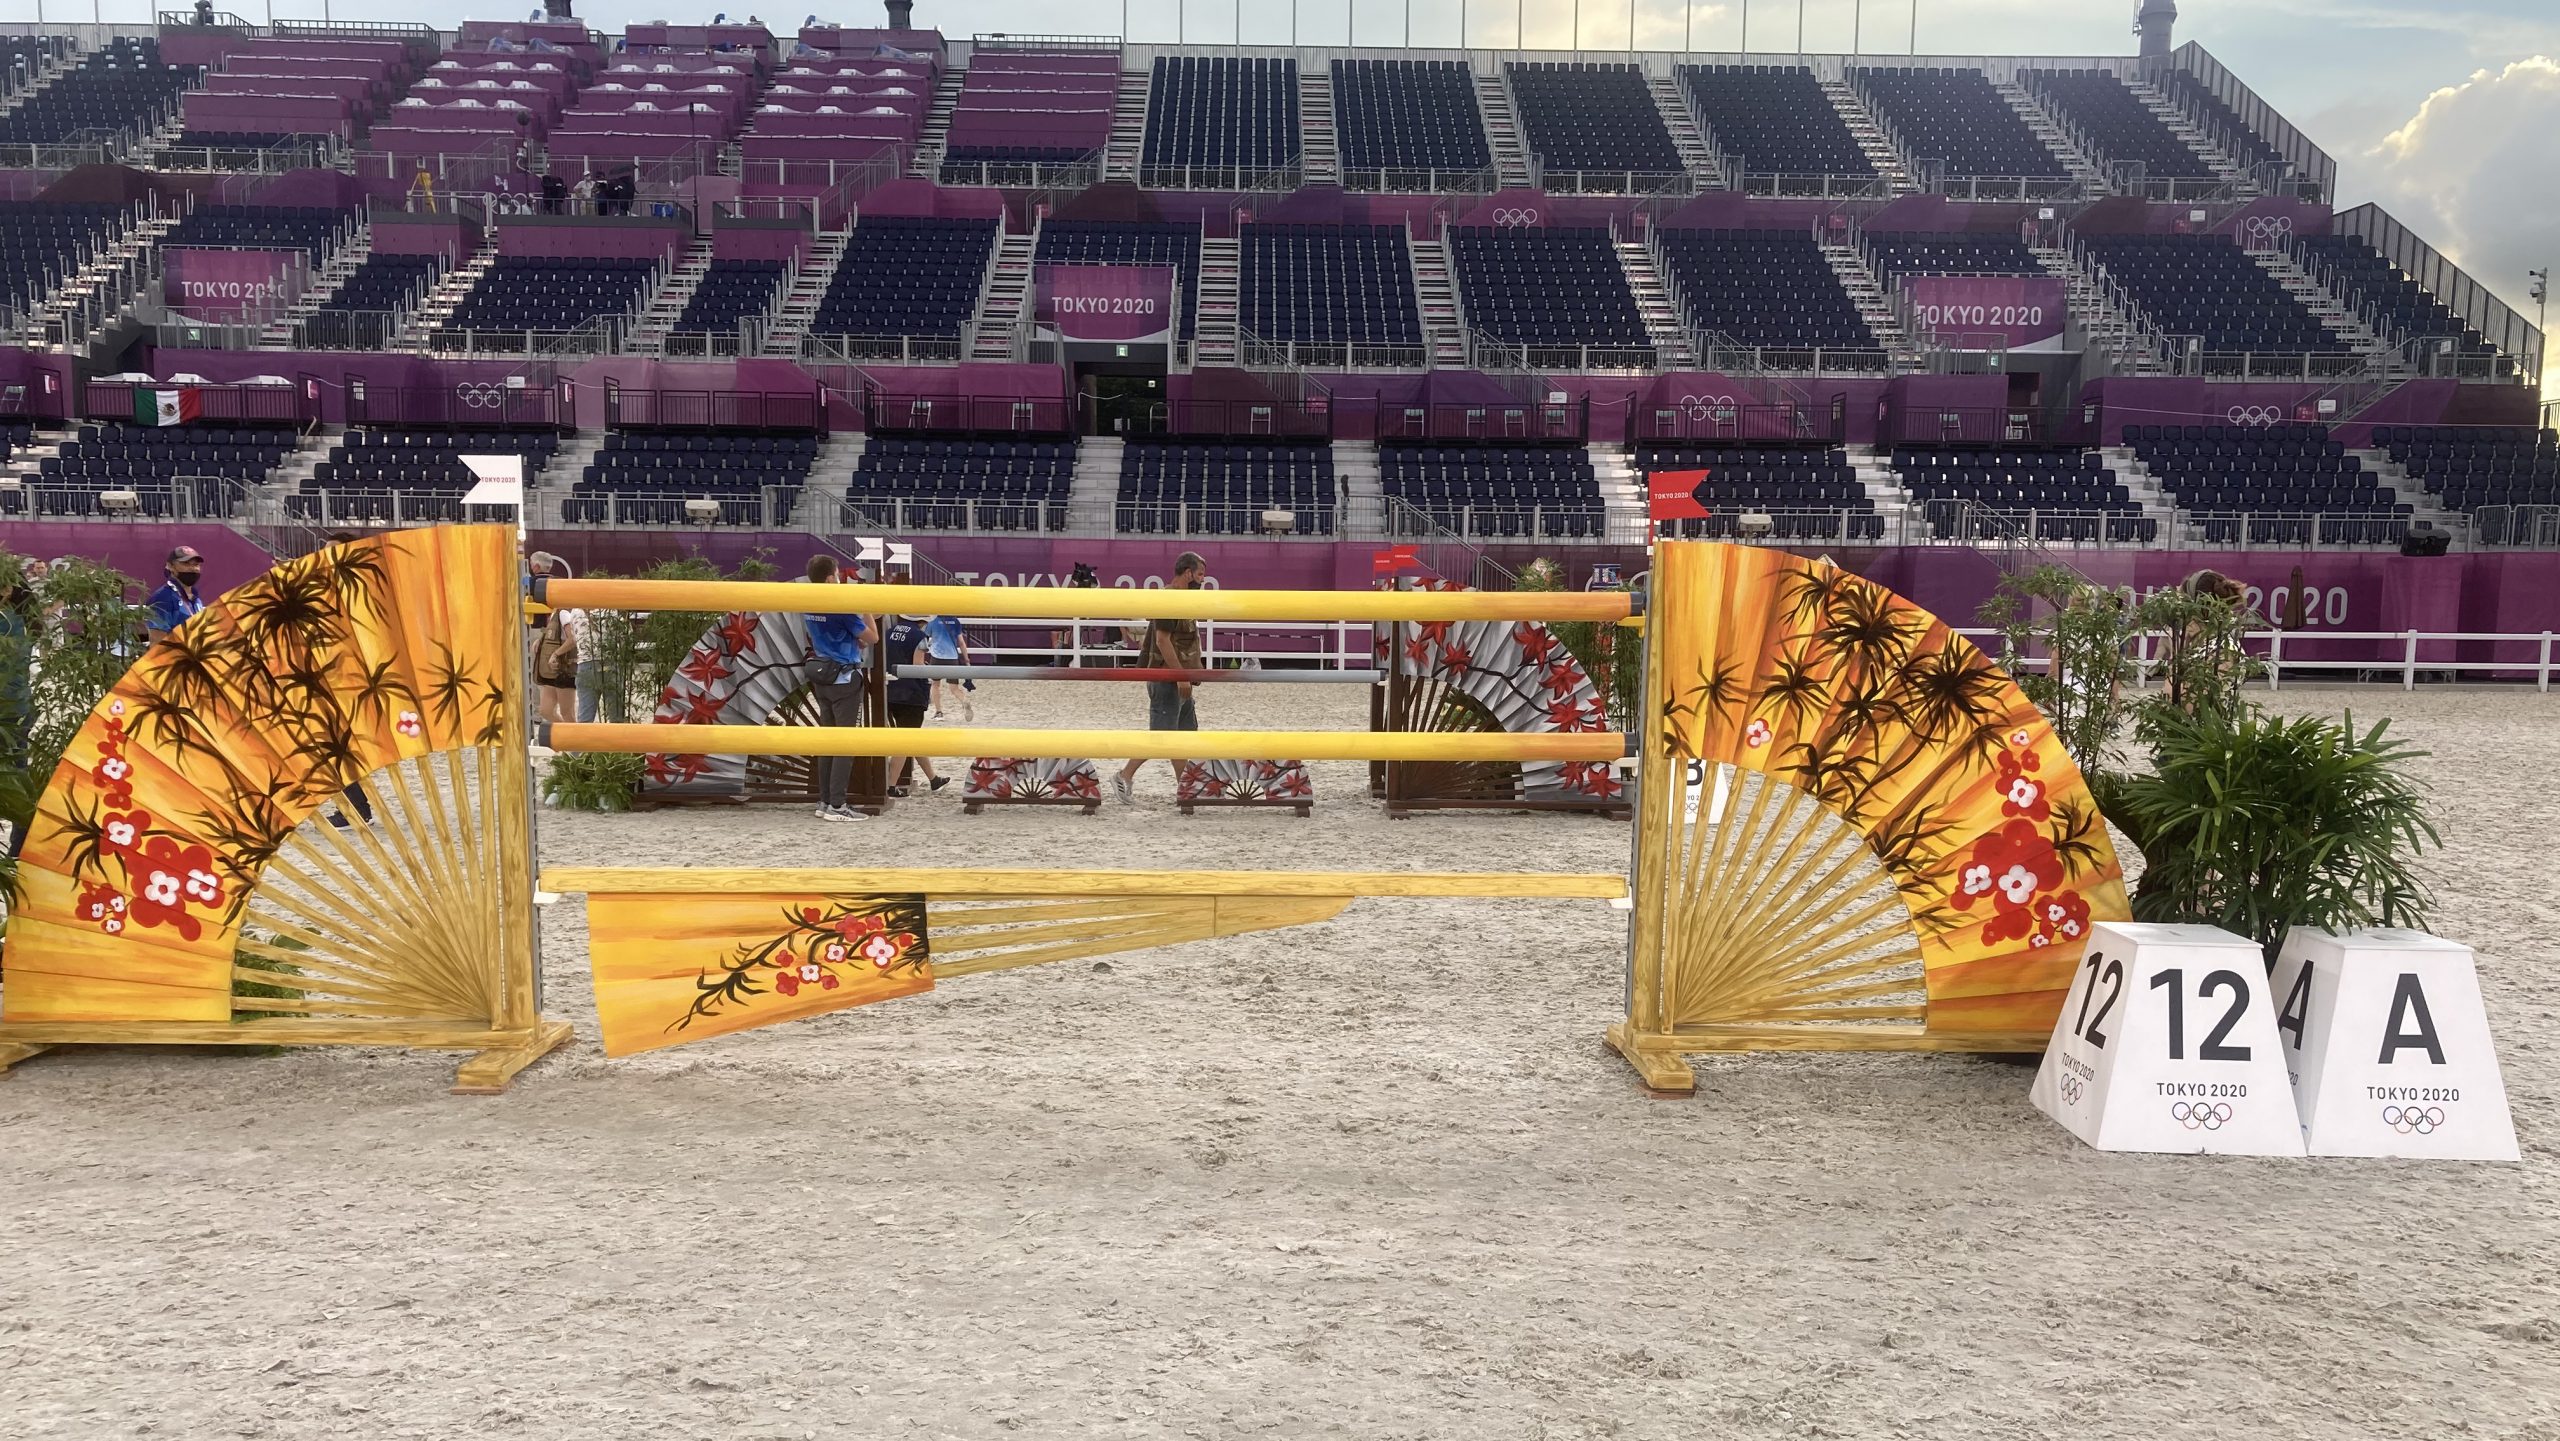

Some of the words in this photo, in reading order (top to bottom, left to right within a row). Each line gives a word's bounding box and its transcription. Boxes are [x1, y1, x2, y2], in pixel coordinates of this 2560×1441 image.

[181, 281, 240, 298] TOKYO
[1051, 296, 1109, 314] TOKYO
[1112, 297, 1155, 315] 2020
[1916, 305, 1985, 325] TOKYO
[1989, 306, 2042, 326] 2020
[893, 625, 912, 633] PHOTO
[2075, 951, 2124, 1050] 12
[2278, 959, 2314, 1050] A
[2150, 968, 2251, 1061] 12
[2378, 973, 2446, 1064] A
[2062, 1052, 2081, 1073] TOKYO
[2079, 1063, 2095, 1082] 2020
[2156, 1083, 2206, 1097] TOKYO
[2210, 1084, 2247, 1098] 2020
[2367, 1086, 2418, 1100] TOKYO
[2422, 1088, 2460, 1102] 2020
